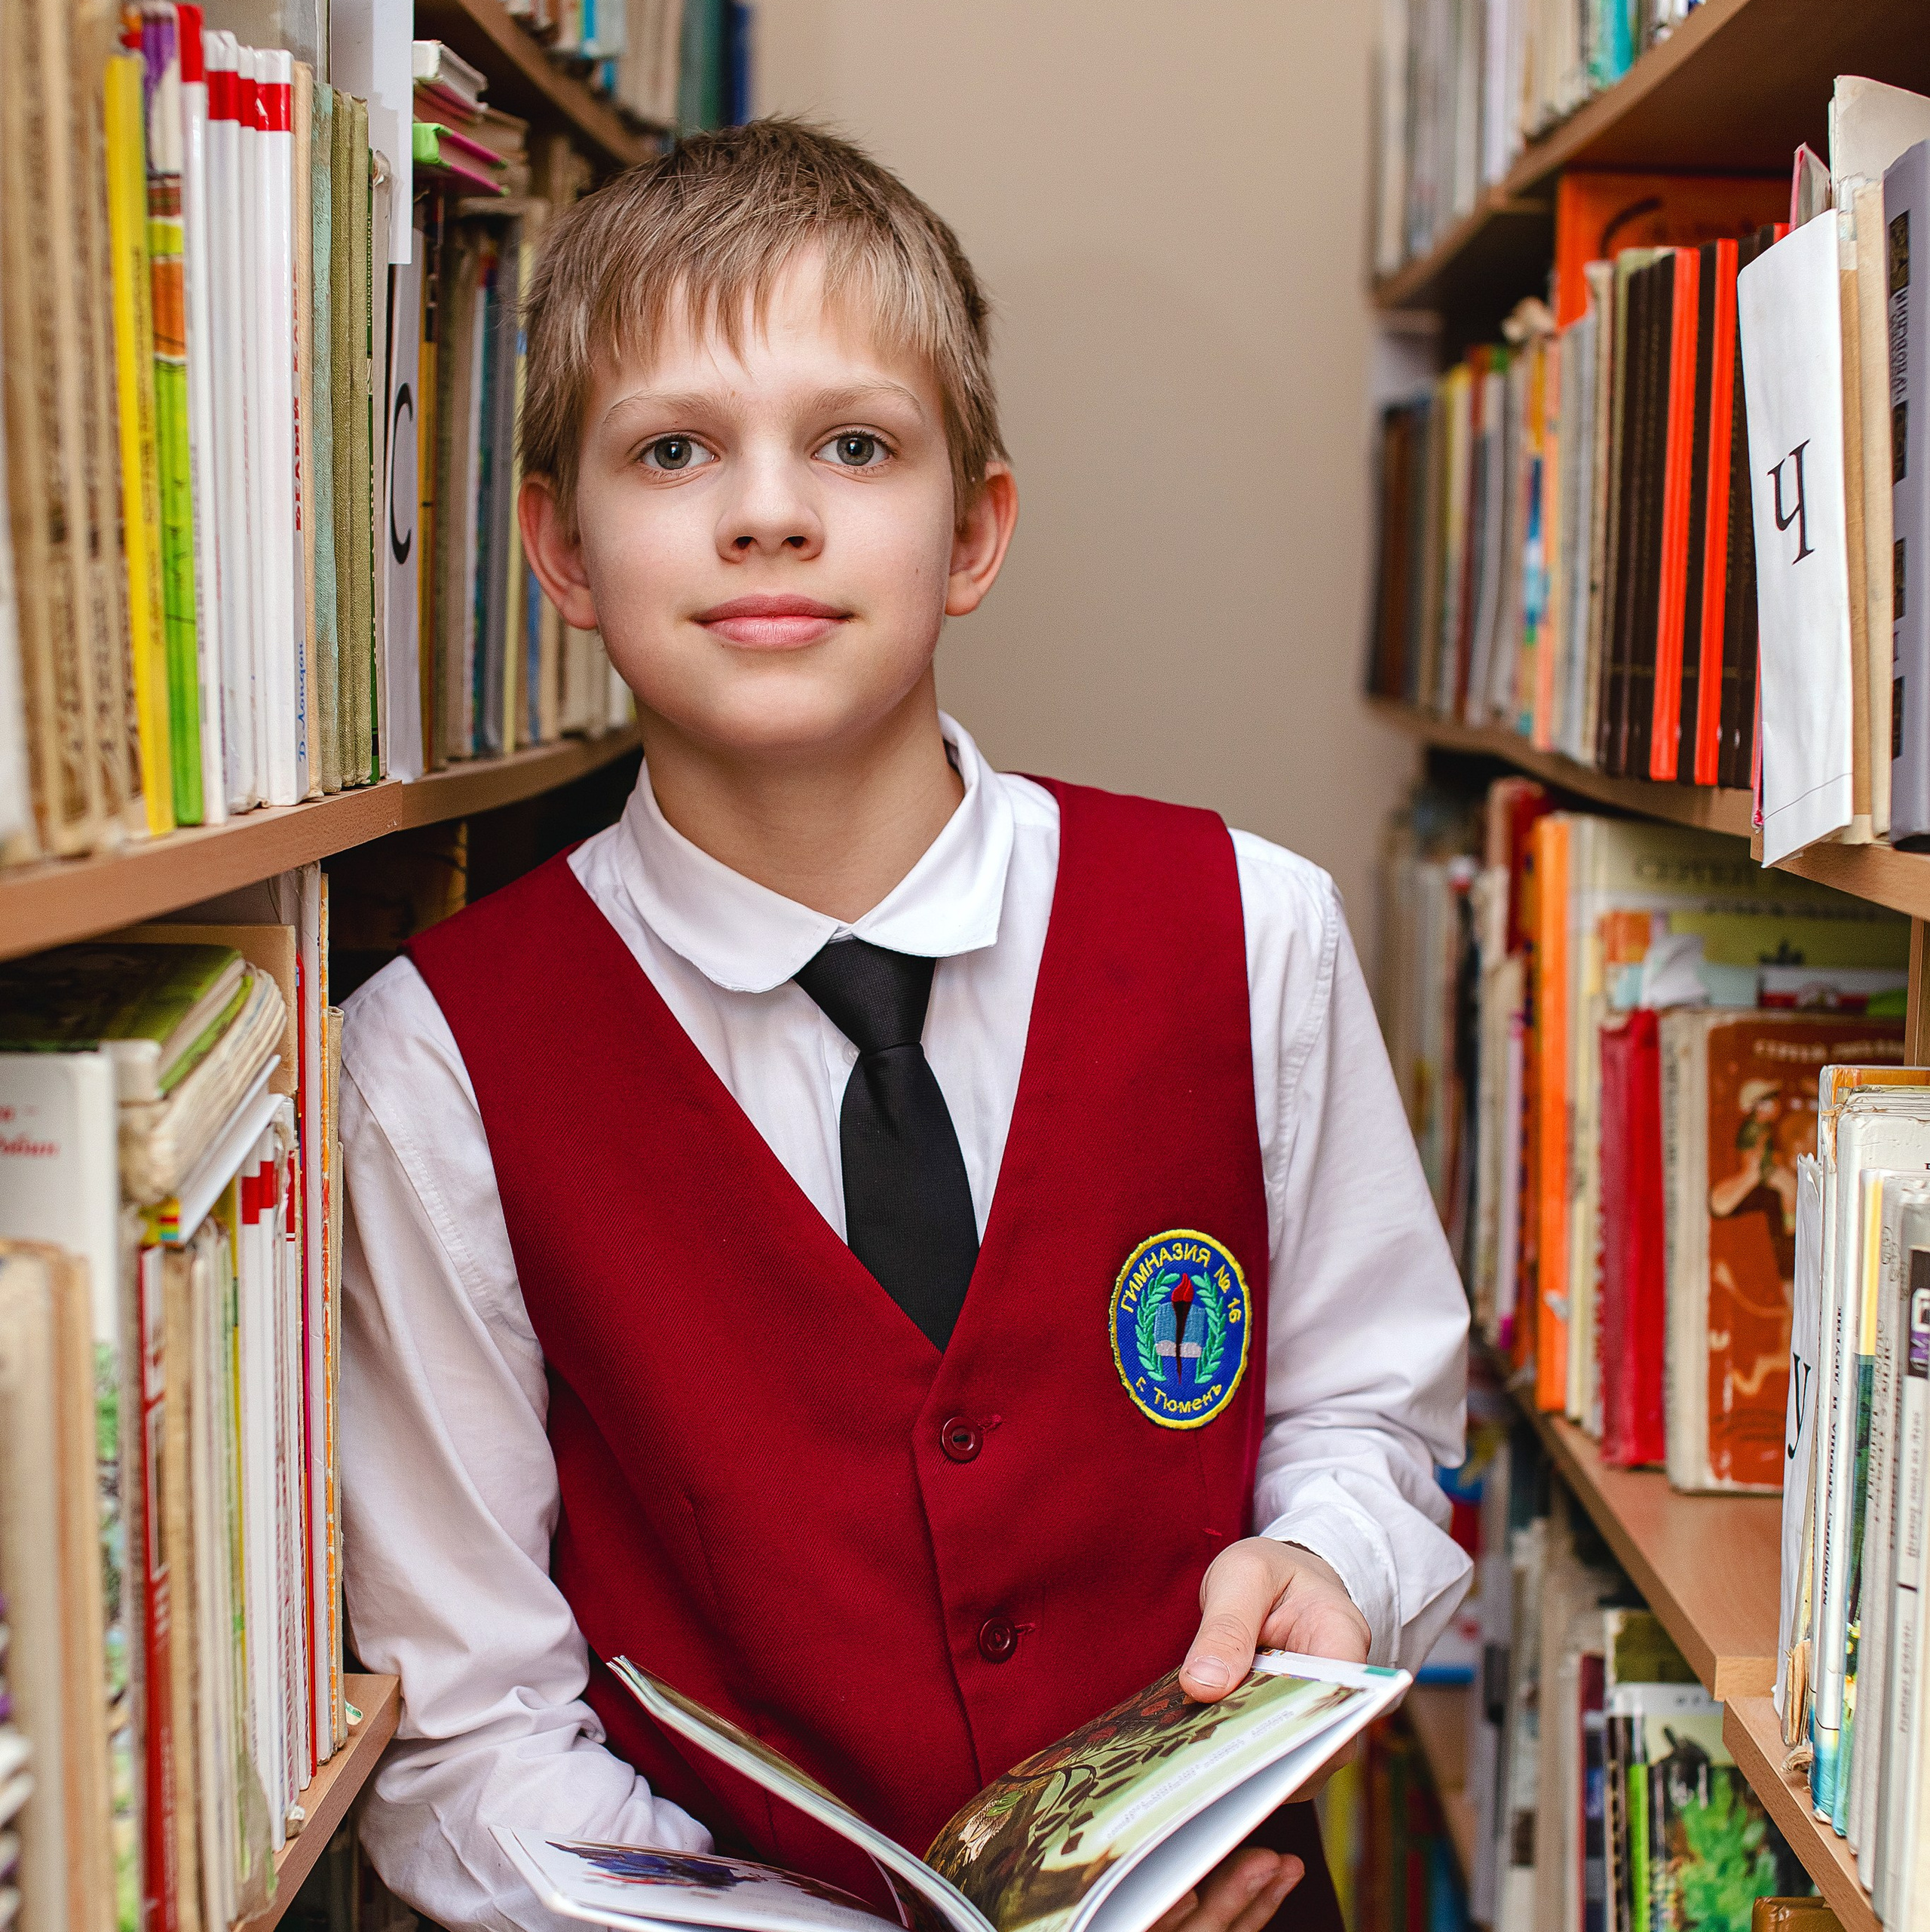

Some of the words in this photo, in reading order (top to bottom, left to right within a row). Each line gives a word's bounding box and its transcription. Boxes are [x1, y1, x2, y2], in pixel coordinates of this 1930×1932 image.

[390, 382, 414, 565] С
[1766, 437, 1816, 566] Ч
[1120, 1242, 1212, 1314] ГИМНАЗИЯ
[1213, 1263, 1232, 1295] №
[1227, 1296, 1242, 1324] 16
[1153, 1383, 1223, 1414] Тюмень
[1787, 1351, 1812, 1460] У
